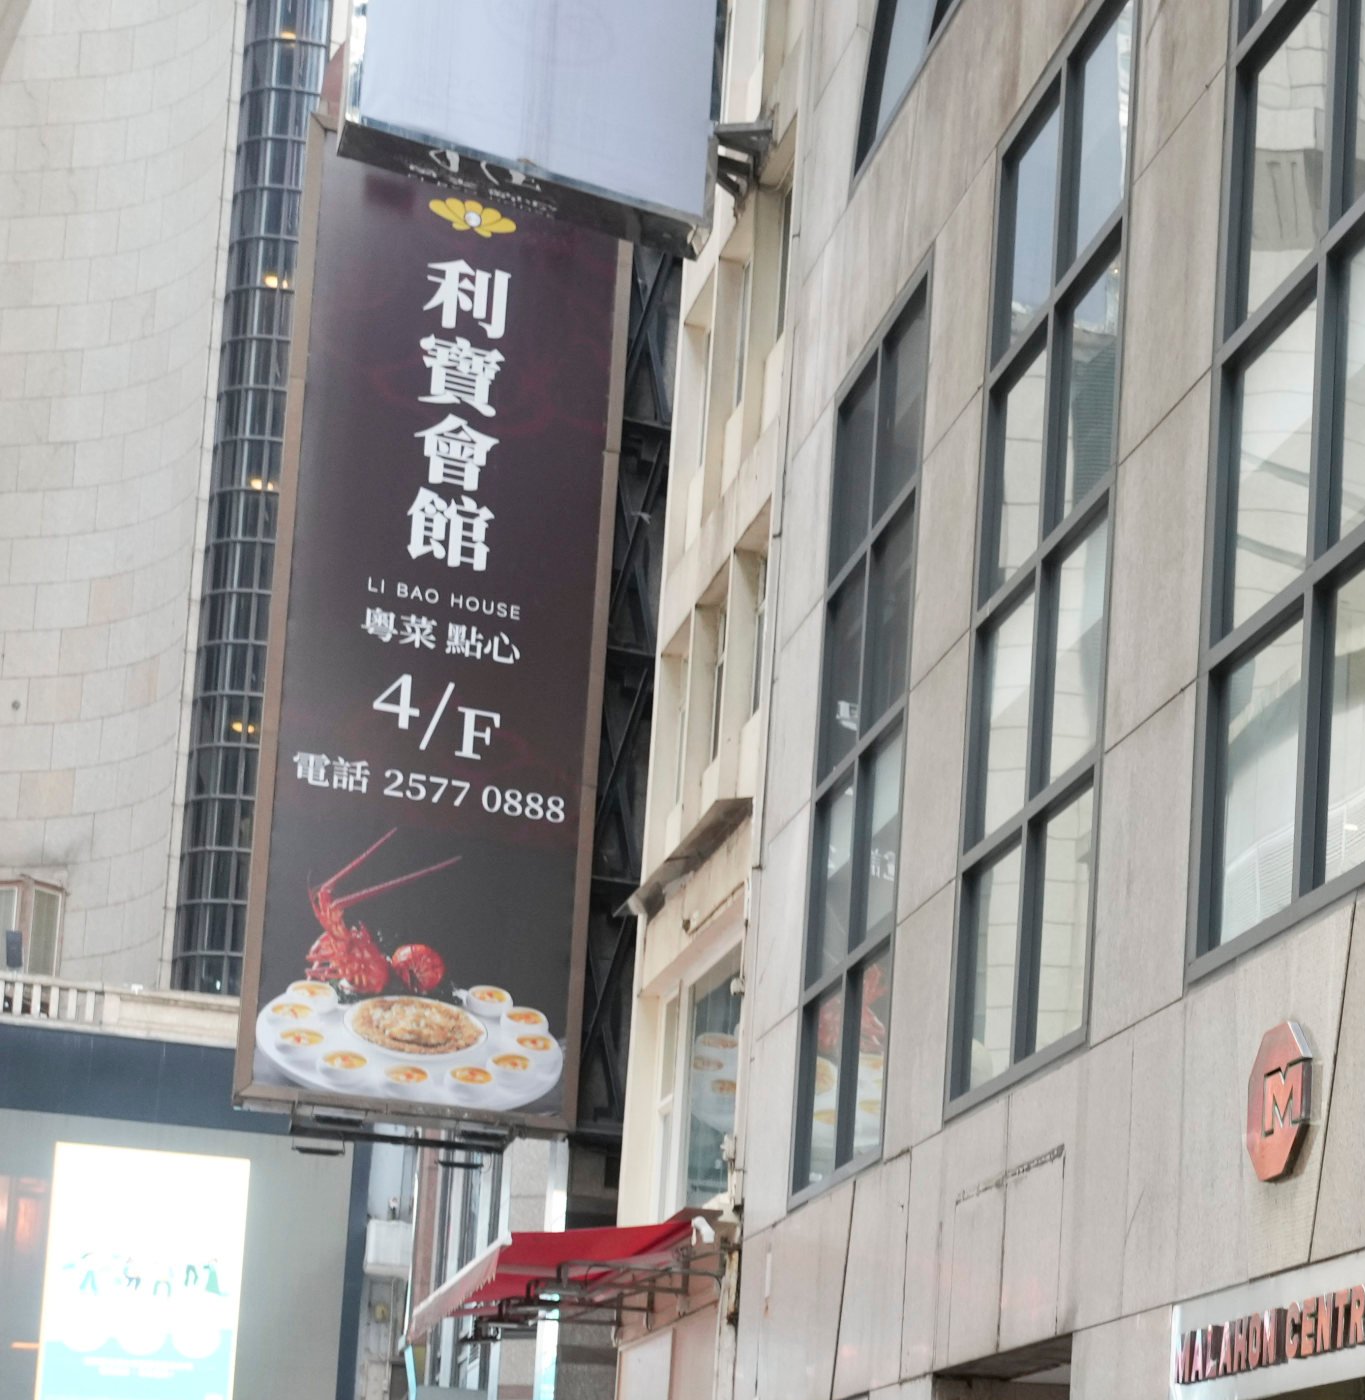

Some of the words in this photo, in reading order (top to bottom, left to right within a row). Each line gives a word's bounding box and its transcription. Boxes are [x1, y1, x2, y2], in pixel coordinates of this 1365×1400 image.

[406, 258, 512, 572] 利寶會館
[367, 576, 385, 595] LI
[396, 582, 440, 605] BAO
[450, 592, 521, 620] HOUSE
[445, 622, 521, 665] 點心
[372, 673, 502, 761] 4/F
[293, 751, 371, 794] 電話
[384, 768, 471, 808] 2577
[481, 784, 565, 824] 0888
[1262, 1056, 1306, 1138] M
[1174, 1307, 1284, 1385] MALAHON
